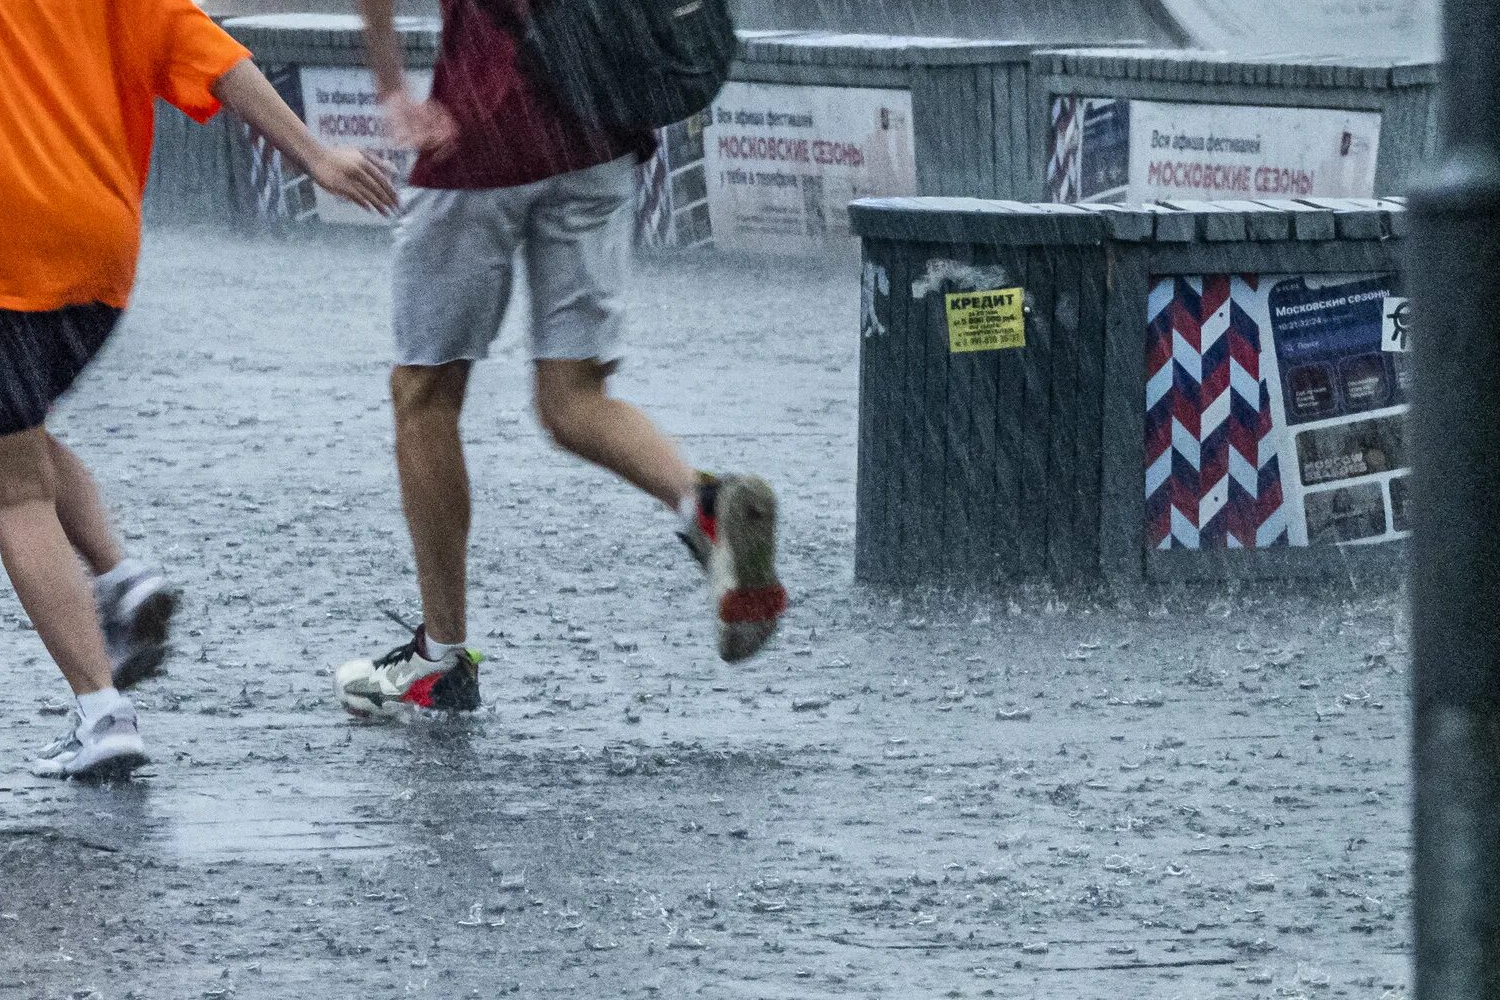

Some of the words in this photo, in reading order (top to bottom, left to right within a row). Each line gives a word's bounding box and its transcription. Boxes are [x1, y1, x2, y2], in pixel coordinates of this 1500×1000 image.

[718, 136, 810, 164] МОСКОВСКИЕ
[813, 139, 865, 167] СЕЗОНЫ
[1151, 129, 1171, 149] Вся
[1172, 132, 1204, 151] афиша
[1206, 133, 1261, 154] фестивалей
[1147, 160, 1251, 191] МОСКОВСКИЕ
[1254, 166, 1316, 195] СЕЗОНЫ
[950, 293, 1014, 310] КРЕДИТ
[1275, 296, 1346, 318] Московские
[1347, 289, 1390, 305] сезоны
